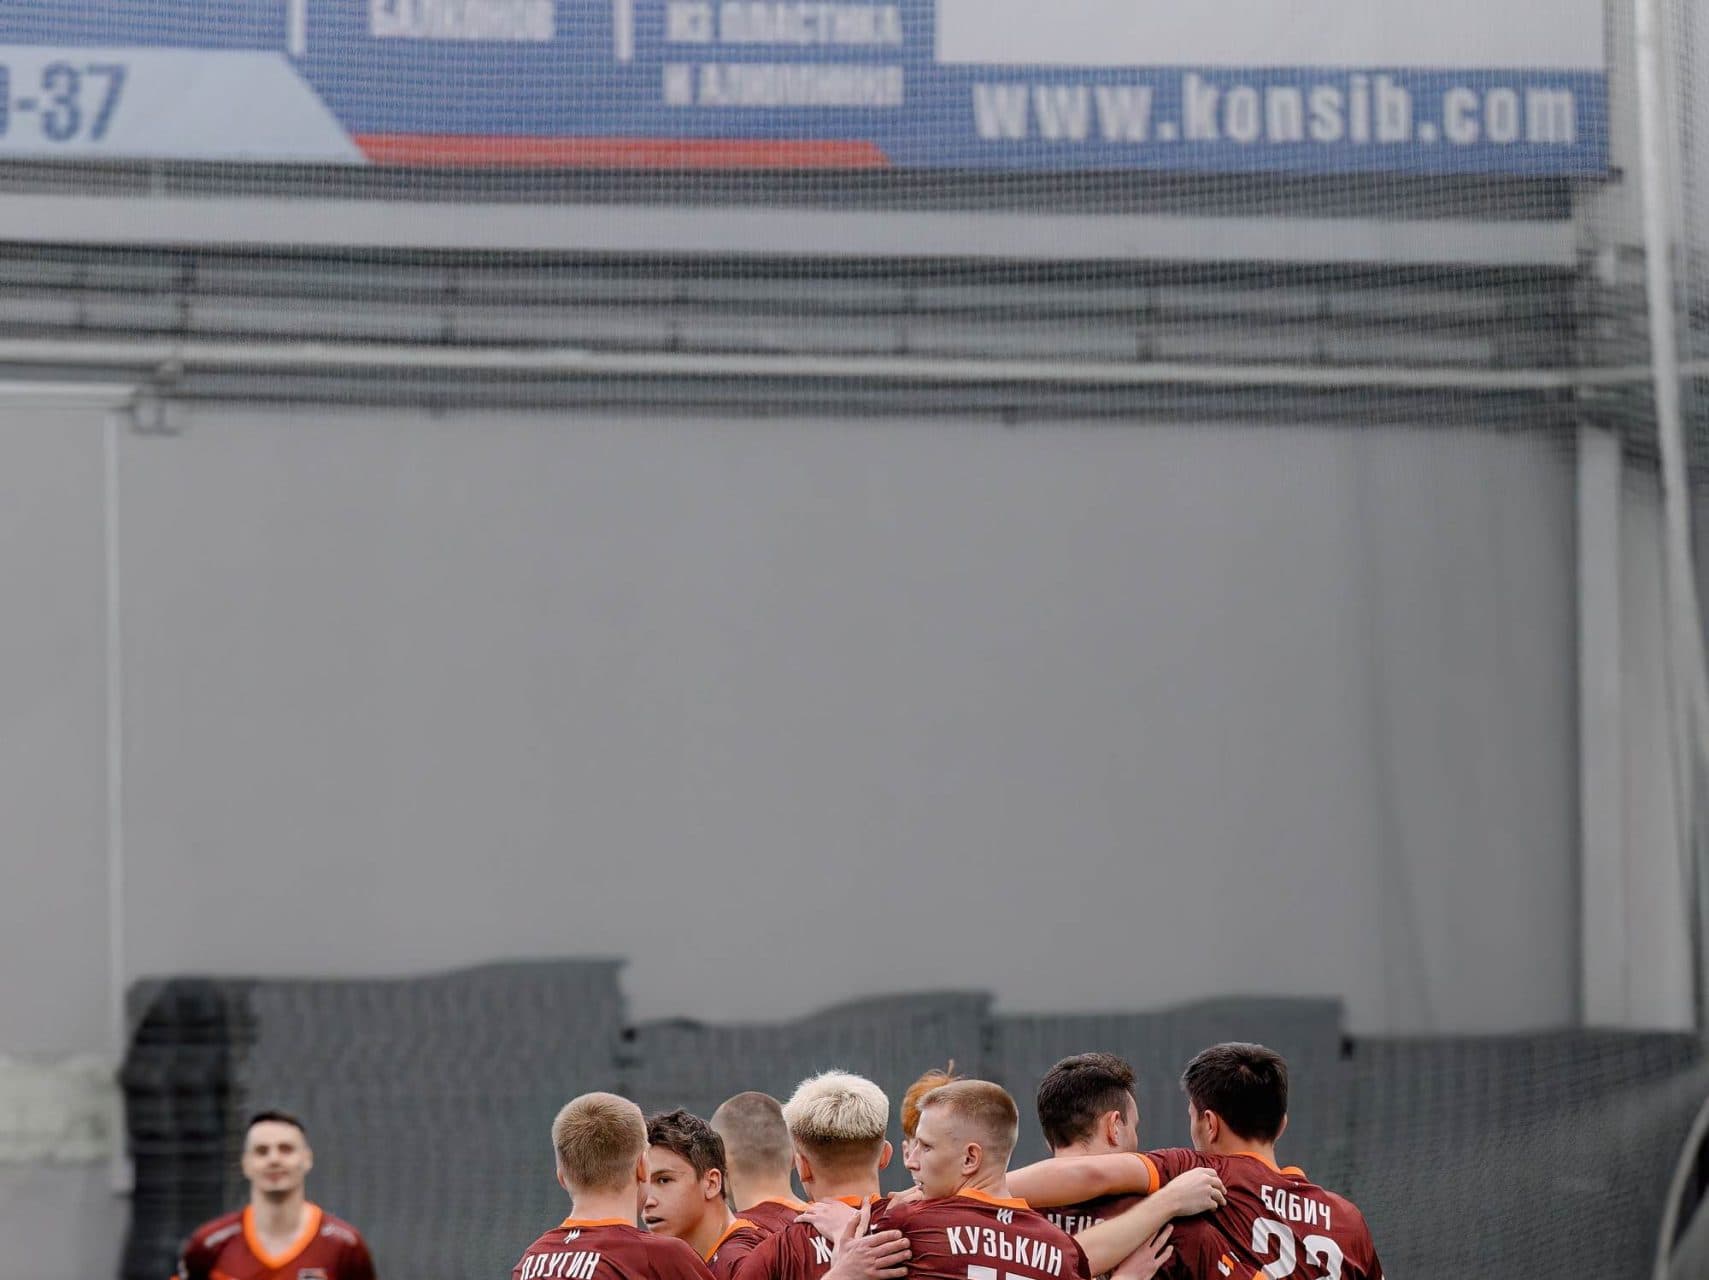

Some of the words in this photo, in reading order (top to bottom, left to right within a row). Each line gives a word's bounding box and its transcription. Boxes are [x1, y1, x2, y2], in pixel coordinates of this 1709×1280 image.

[0, 61, 128, 142] -37
[972, 73, 1576, 144] www.konsib.com
[1260, 1184, 1331, 1231] БАБИЧ
[946, 1226, 1063, 1277] КУЗЬКИН
